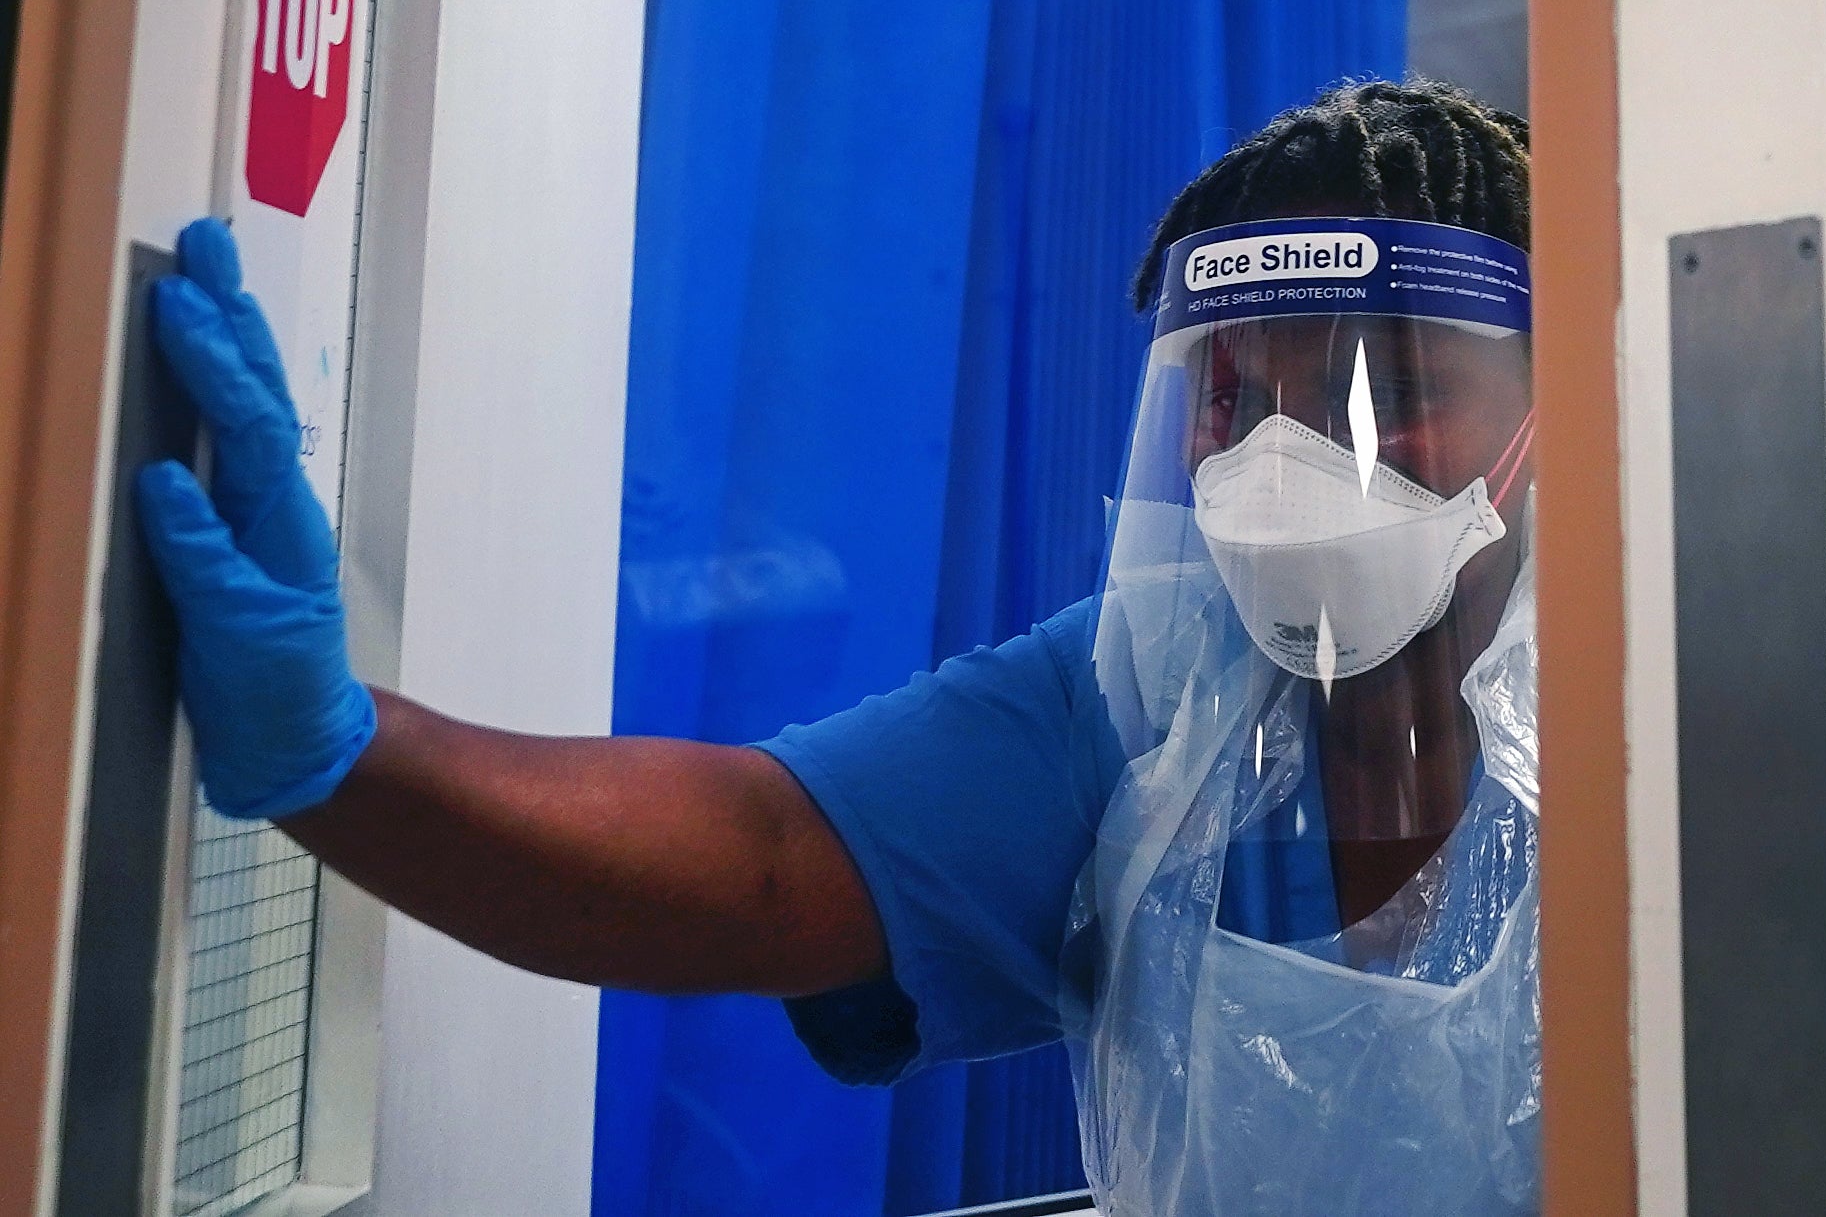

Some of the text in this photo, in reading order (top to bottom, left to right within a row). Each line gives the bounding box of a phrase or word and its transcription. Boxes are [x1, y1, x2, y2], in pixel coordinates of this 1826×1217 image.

[1192, 242, 1363, 283] Face Shield
[1202, 294, 1229, 310] FACE
[1231, 289, 1275, 305] SHIELD
[1278, 287, 1367, 300] PROTECTION
